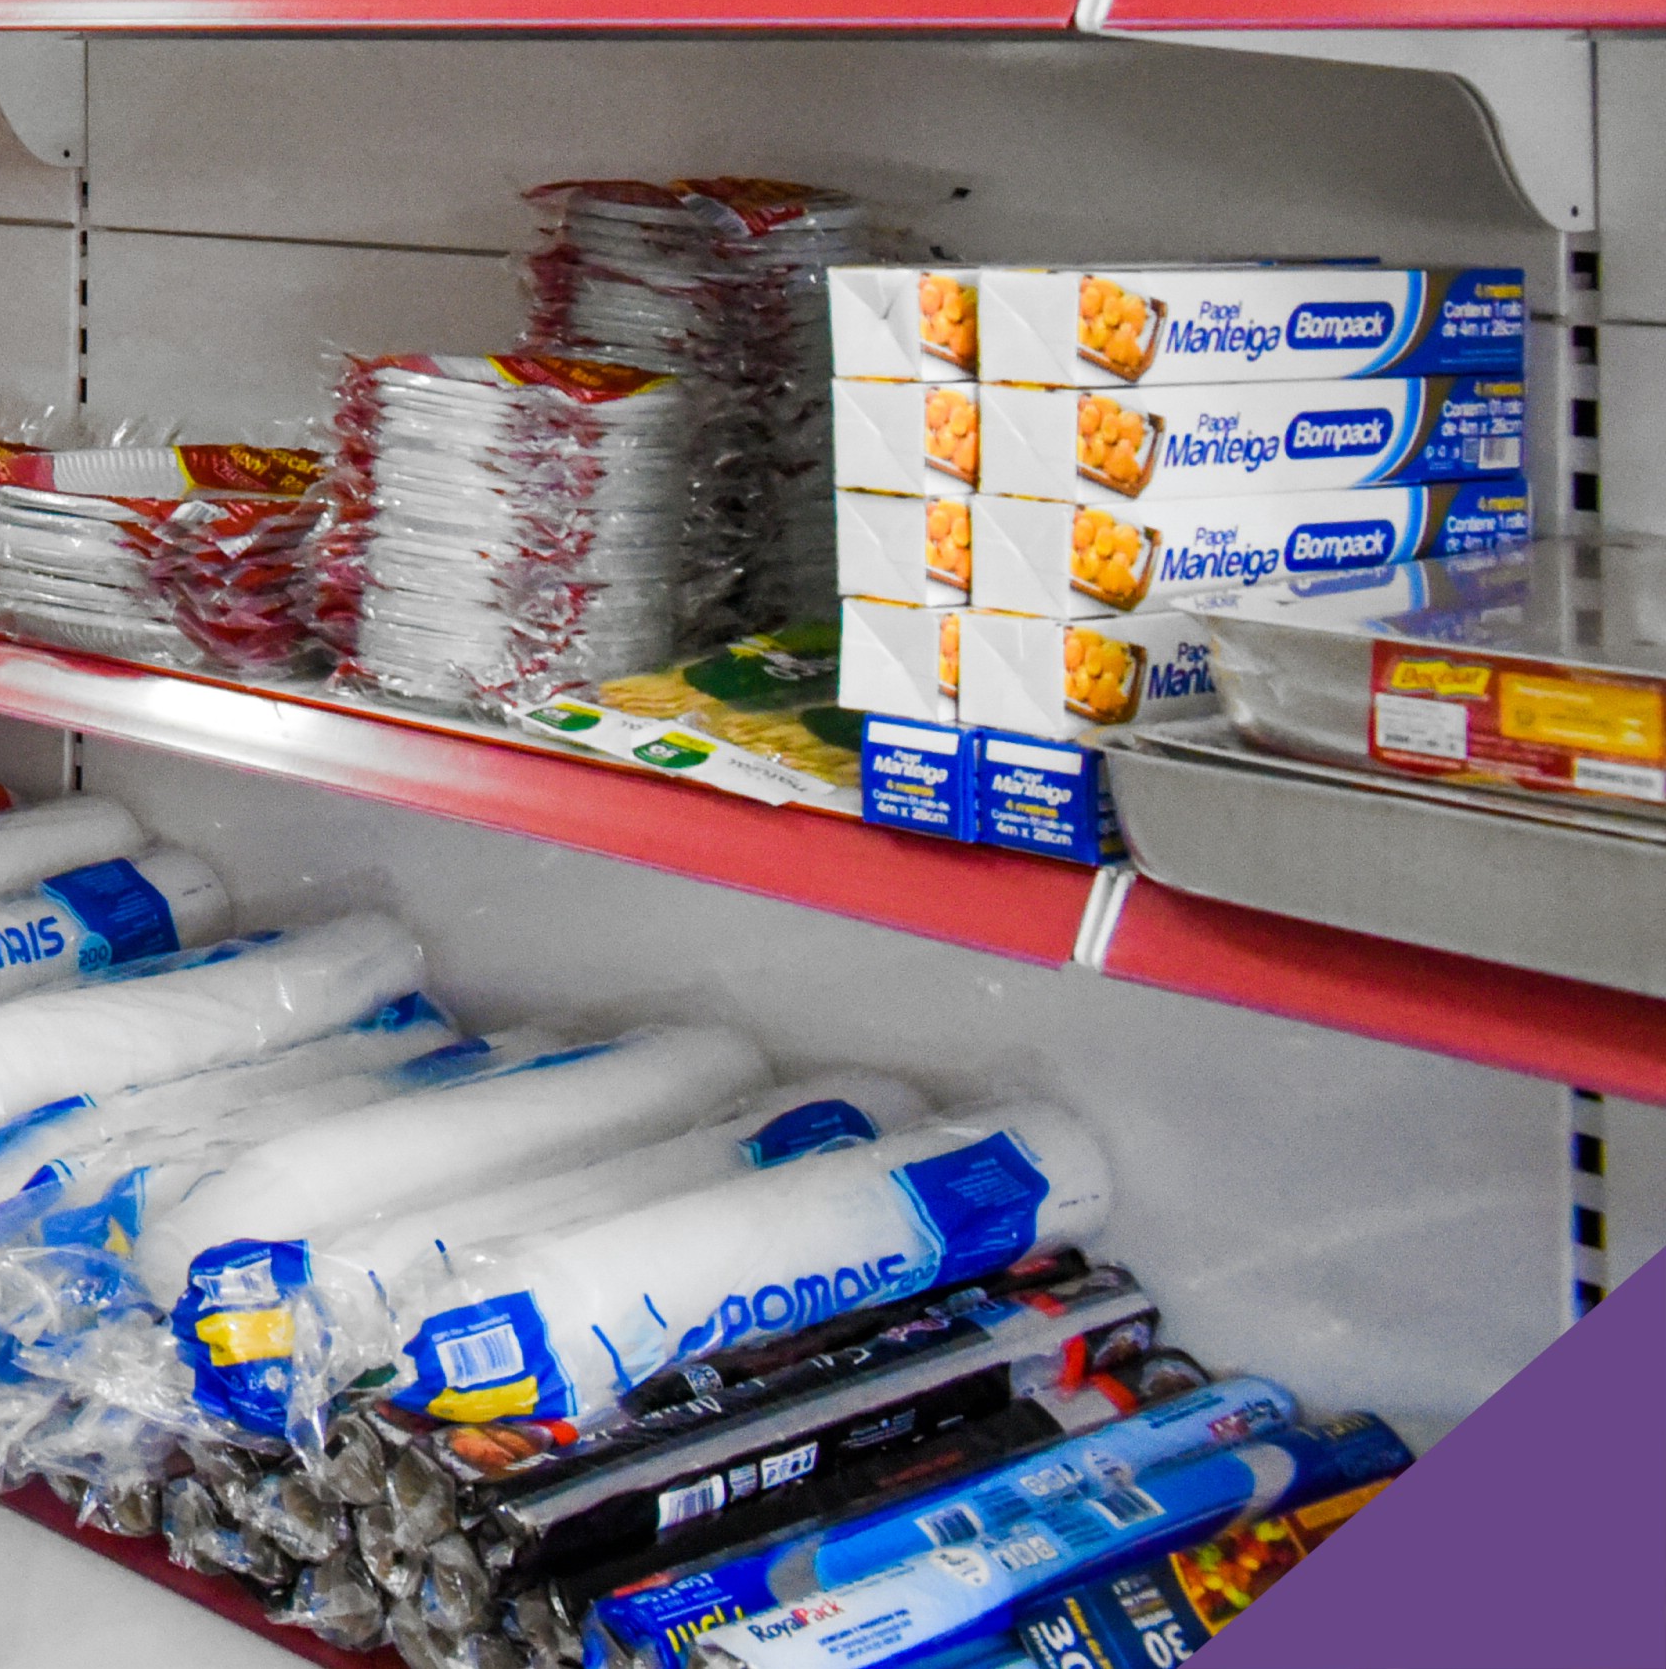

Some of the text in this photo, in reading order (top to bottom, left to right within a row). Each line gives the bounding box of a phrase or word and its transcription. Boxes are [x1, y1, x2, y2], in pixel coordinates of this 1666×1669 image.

[1199, 300, 1242, 320] Papel
[1293, 310, 1386, 344] Bompack
[1166, 319, 1281, 362] Manteiga
[1197, 412, 1241, 433] Papel
[1292, 418, 1385, 452] Bompack
[1164, 431, 1280, 472] Manteiga
[1195, 526, 1239, 546] Papel
[1292, 530, 1386, 564] Bompack
[1160, 545, 1279, 586] Manteiga
[873, 755, 949, 786] Manteiga
[992, 773, 1072, 806] Manteiga
[78, 943, 109, 969] 200
[747, 1598, 846, 1643] RoyalPack
